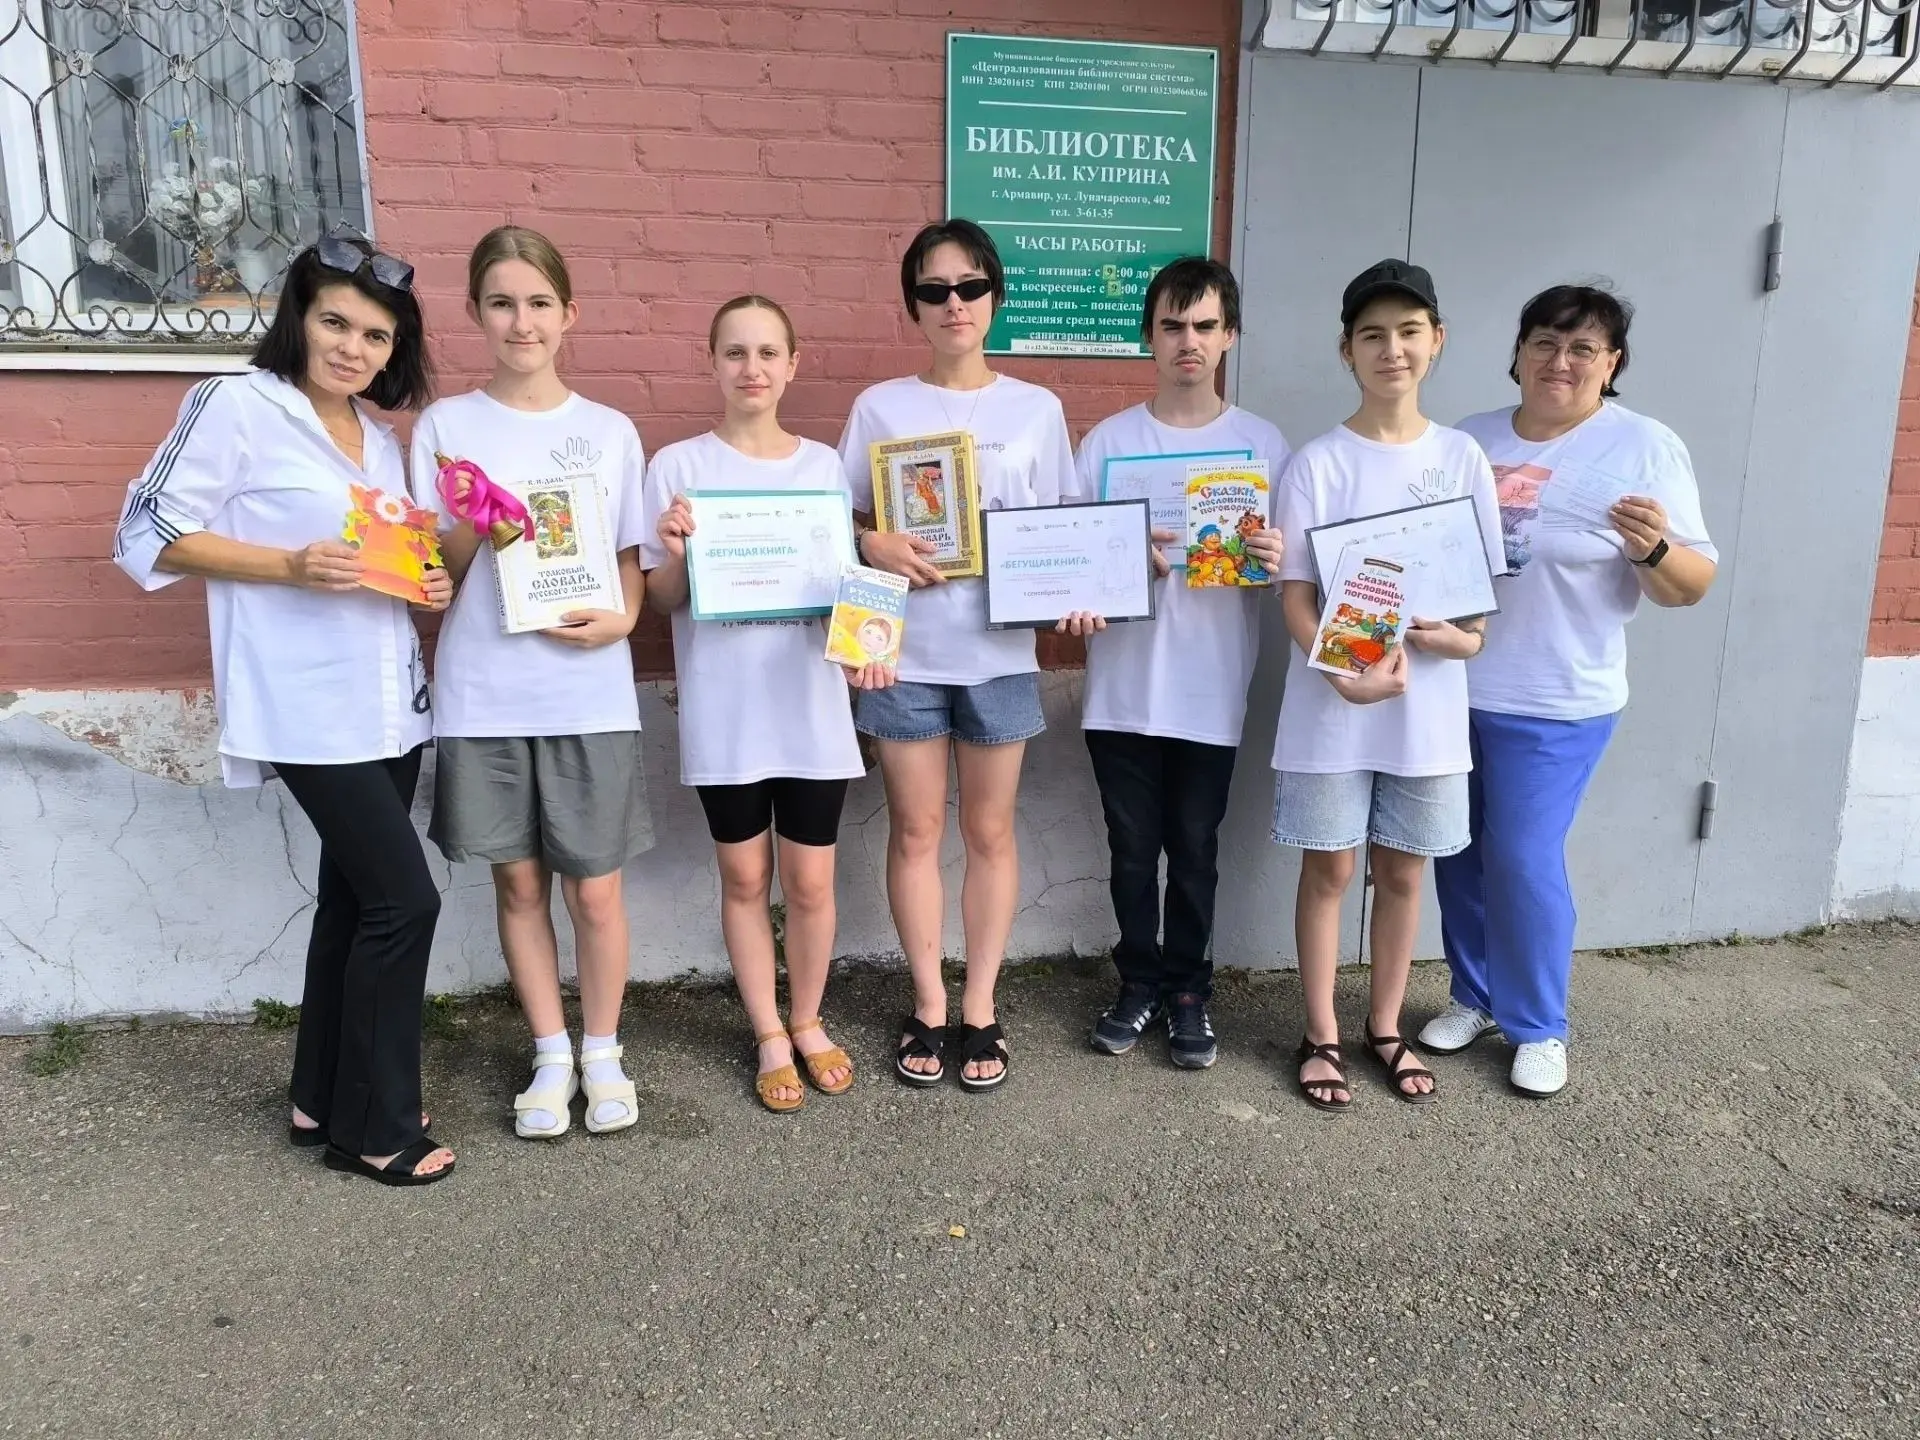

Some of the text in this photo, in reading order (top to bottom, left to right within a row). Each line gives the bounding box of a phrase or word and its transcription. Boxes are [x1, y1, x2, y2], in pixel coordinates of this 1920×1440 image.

[993, 51, 1175, 70] Муниципальное бюджетное учреждение культуры
[972, 61, 1195, 83] «Централизованная библиотечная система»
[962, 76, 983, 84] ИНН
[988, 77, 1035, 88] 2302016152
[1044, 80, 1065, 89] КПП
[1069, 82, 1110, 92] 230201001
[1122, 85, 1147, 93] ОГРН
[965, 126, 1198, 163] БИБЛИОТЕКА
[992, 164, 1171, 186] им. А.И. КУПРИНА
[992, 190, 1171, 205] г. Армавир, ул. Луначарского, 402
[1049, 207, 1113, 218] тел. 3-61-35
[1015, 236, 1146, 253] ЧАСЫ РАБОТЫ:
[1038, 267, 1091, 278] пятница:
[1135, 270, 1149, 279] до
[1021, 283, 1096, 295] воскресенье:
[1000, 299, 1049, 309] ыходной
[1051, 301, 1078, 310] день
[1091, 302, 1143, 312] понедель
[1006, 315, 1063, 325] последняя
[1065, 316, 1095, 327] среда
[1098, 317, 1136, 327] месяца
[1029, 331, 1124, 342] санитарный день
[705, 546, 798, 558] «БЕГУЩАЯ КНИГА»
[1000, 556, 1092, 569] «БЕГУЩАЯ КНИГА»
[532, 573, 595, 590] СЛОВАРЬ
[1357, 572, 1398, 591] Сказки,
[850, 586, 900, 606] РУССКИЕ
[1344, 579, 1405, 602] пословицы,
[1344, 588, 1401, 609] поговорки
[850, 596, 897, 613] СКАЗКИ
